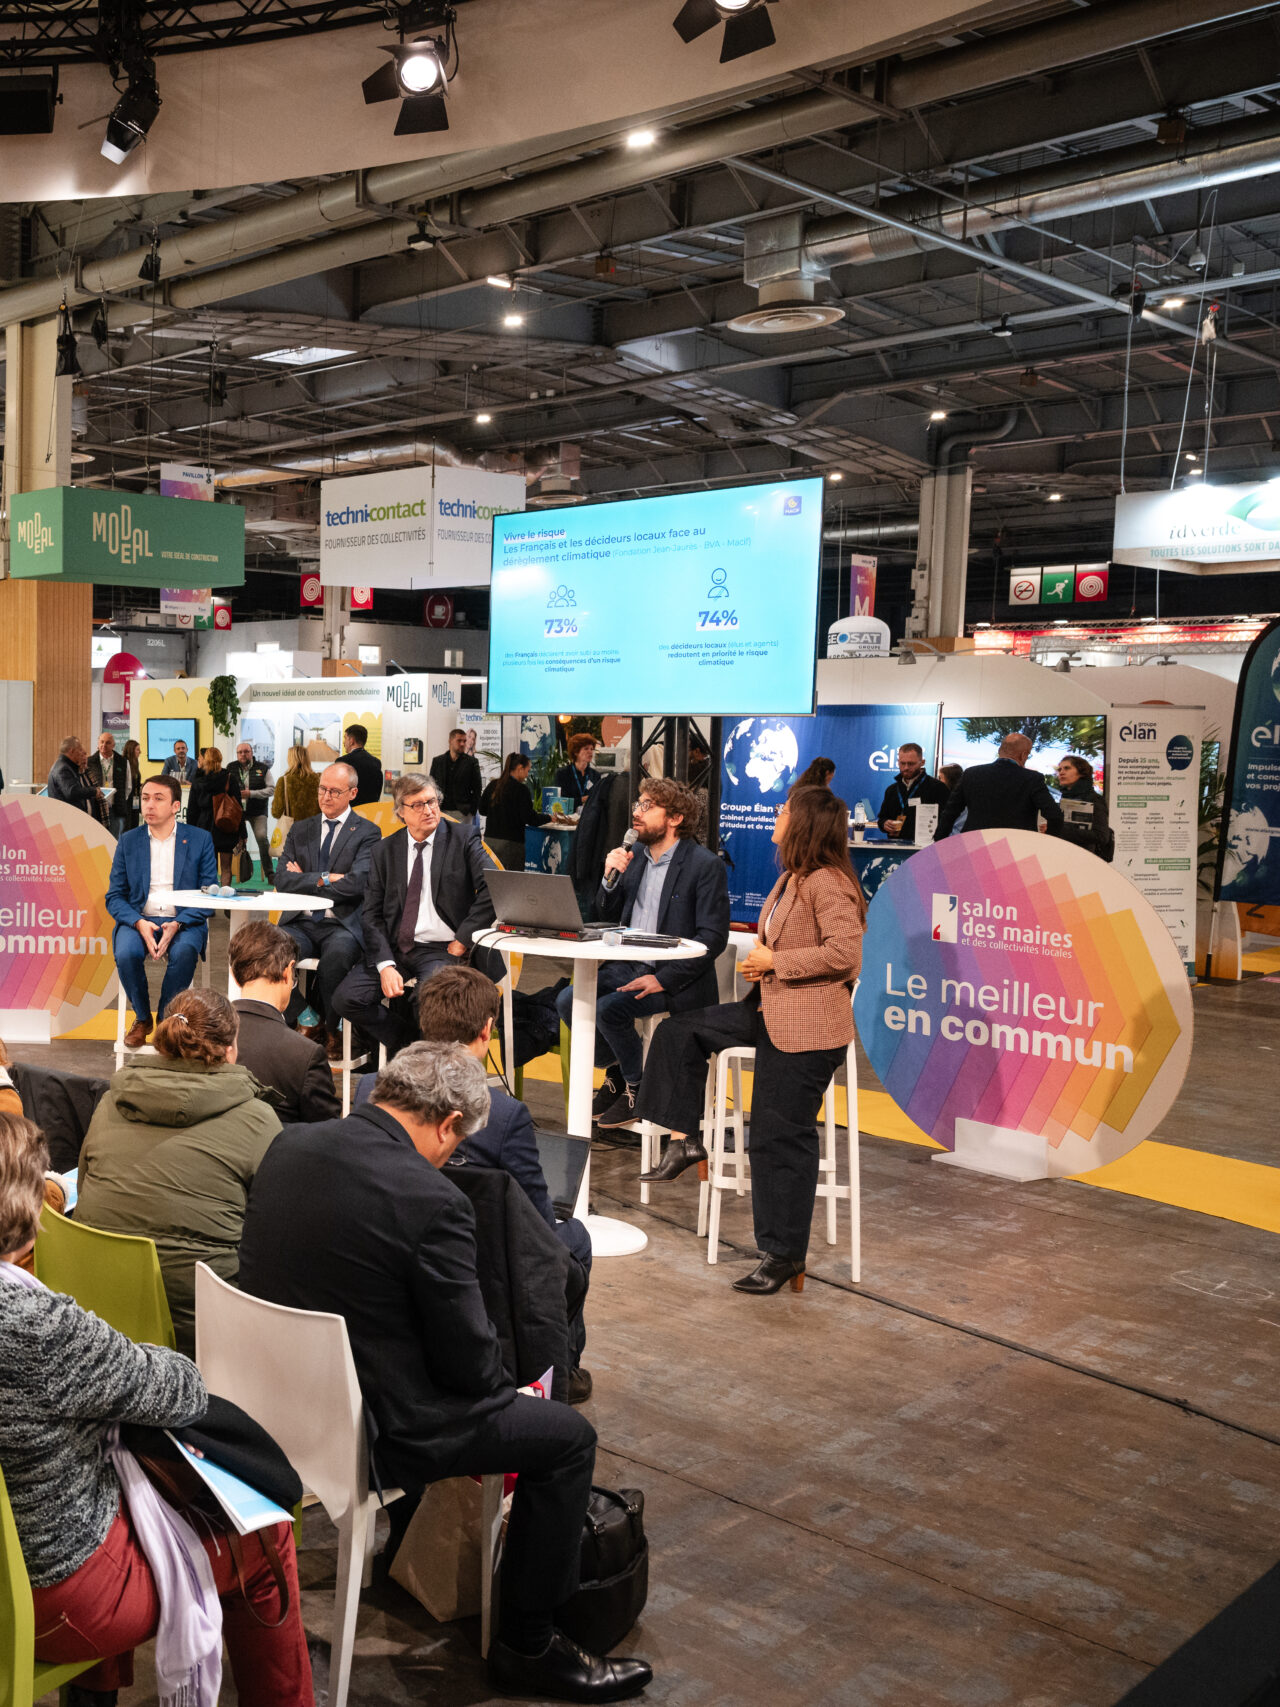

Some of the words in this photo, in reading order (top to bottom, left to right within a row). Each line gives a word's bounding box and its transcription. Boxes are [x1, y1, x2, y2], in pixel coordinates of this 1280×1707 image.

[325, 534, 366, 549] FOURNISSEUR
[367, 533, 379, 545] DES
[380, 527, 426, 544] COLLECTIVITÉS
[438, 529, 473, 542] FOURNISSEUR
[474, 531, 485, 543] DES
[504, 532, 525, 541] Vivre
[538, 528, 565, 539] risque
[1170, 521, 1238, 540] idverde
[504, 546, 518, 554] Les
[520, 542, 556, 553] Français
[558, 541, 567, 549] et
[570, 539, 582, 547] les
[585, 534, 631, 546] décideurs
[634, 532, 666, 541] locaux
[669, 528, 690, 538] face
[693, 528, 706, 536] au
[1150, 547, 1178, 557] TOUTES
[1182, 547, 1194, 556] LES
[1198, 544, 1241, 555] SOLUTIONS
[1244, 542, 1265, 552] SONT
[191, 553, 219, 562] CONSTRUCTION
[504, 554, 559, 566] dérèglement
[562, 549, 610, 561] climatique
[855, 595, 869, 616] M
[545, 618, 578, 634] 73%
[699, 610, 738, 627] 74%
[712, 649, 736, 659] priorité
[746, 649, 768, 658] risque
[1120, 720, 1156, 742] élan
[720, 803, 752, 813] Groupe
[754, 803, 773, 813] Élan
[16, 862, 66, 876] maires
[962, 898, 1017, 921] salon
[962, 917, 996, 939] des
[1003, 925, 1073, 949] maires
[962, 937, 970, 946] et
[972, 937, 987, 949] des
[989, 940, 1039, 954] collectivités
[1042, 946, 1072, 959] locales
[886, 962, 928, 1000] Le
[941, 978, 1104, 1028] meilleur
[884, 1004, 930, 1036] en
[941, 1014, 1134, 1074] commun
